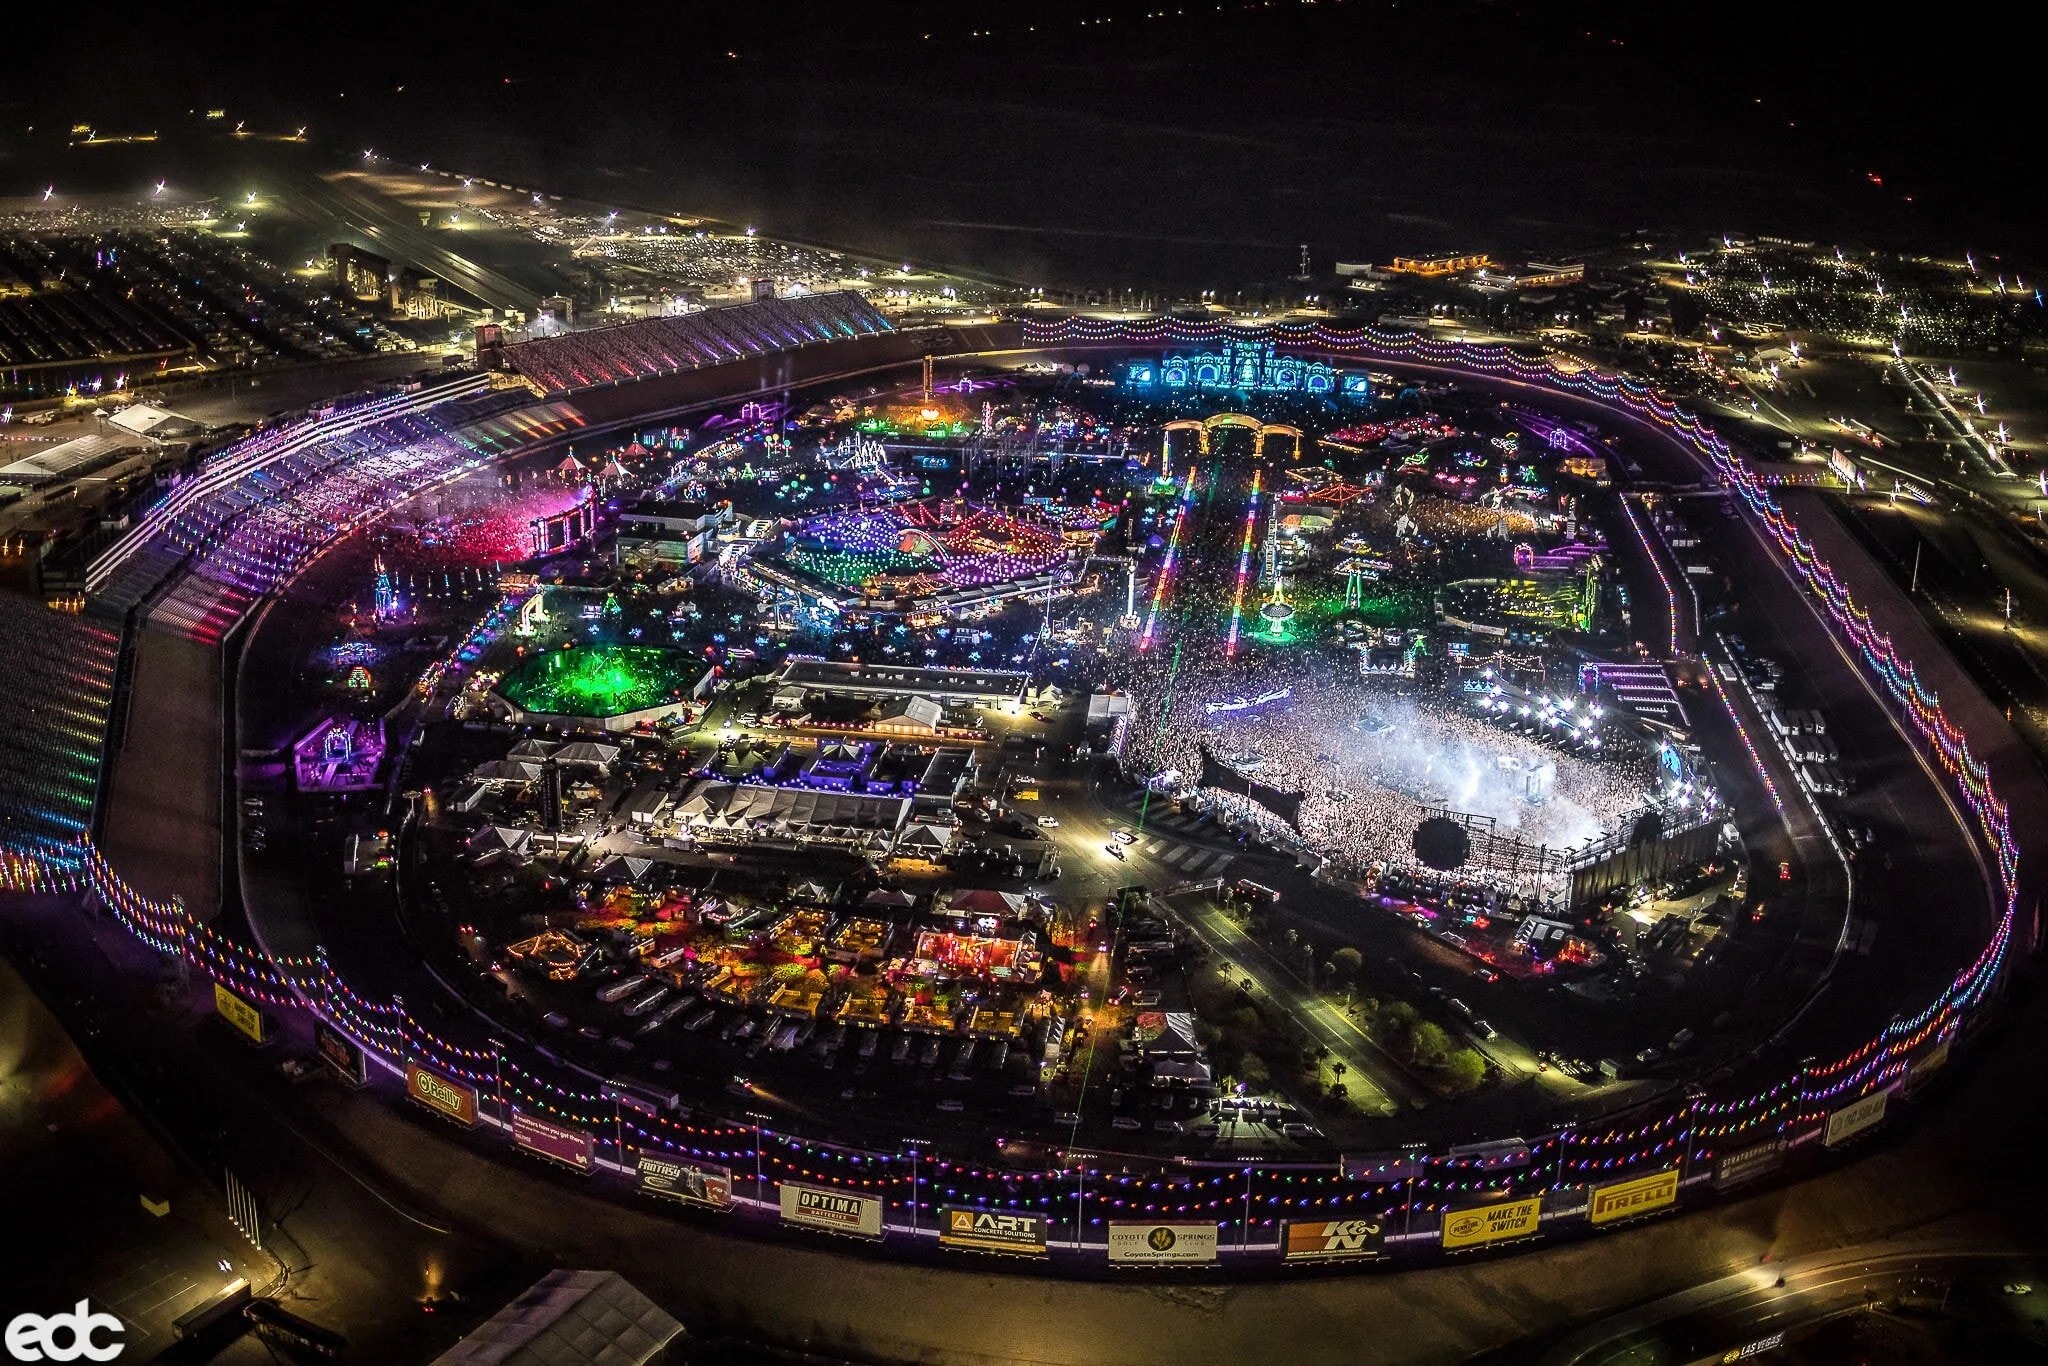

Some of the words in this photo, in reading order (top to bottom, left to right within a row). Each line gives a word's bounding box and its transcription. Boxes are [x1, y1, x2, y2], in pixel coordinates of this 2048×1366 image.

[416, 1070, 462, 1112] O'Reilly
[550, 1128, 560, 1136] you
[637, 1160, 681, 1178] FANTASY
[801, 1192, 859, 1214] OPTIMA
[1595, 1177, 1676, 1215] PIRELLI
[811, 1208, 847, 1220] BATTERIES
[1487, 1207, 1514, 1222] MAKE
[1515, 1204, 1534, 1217] THE
[973, 1227, 1003, 1235] CONCRETE
[1004, 1230, 1036, 1239] SOLUTIONS
[1490, 1216, 1528, 1233] SWITCH
[1111, 1233, 1145, 1241] COYOTE
[1176, 1233, 1215, 1241] SPRINGS
[1123, 1251, 1199, 1259] CoyoteSprings.com
[1741, 1342, 1756, 1356] LAS
[1757, 1334, 1782, 1351] VEGAS
